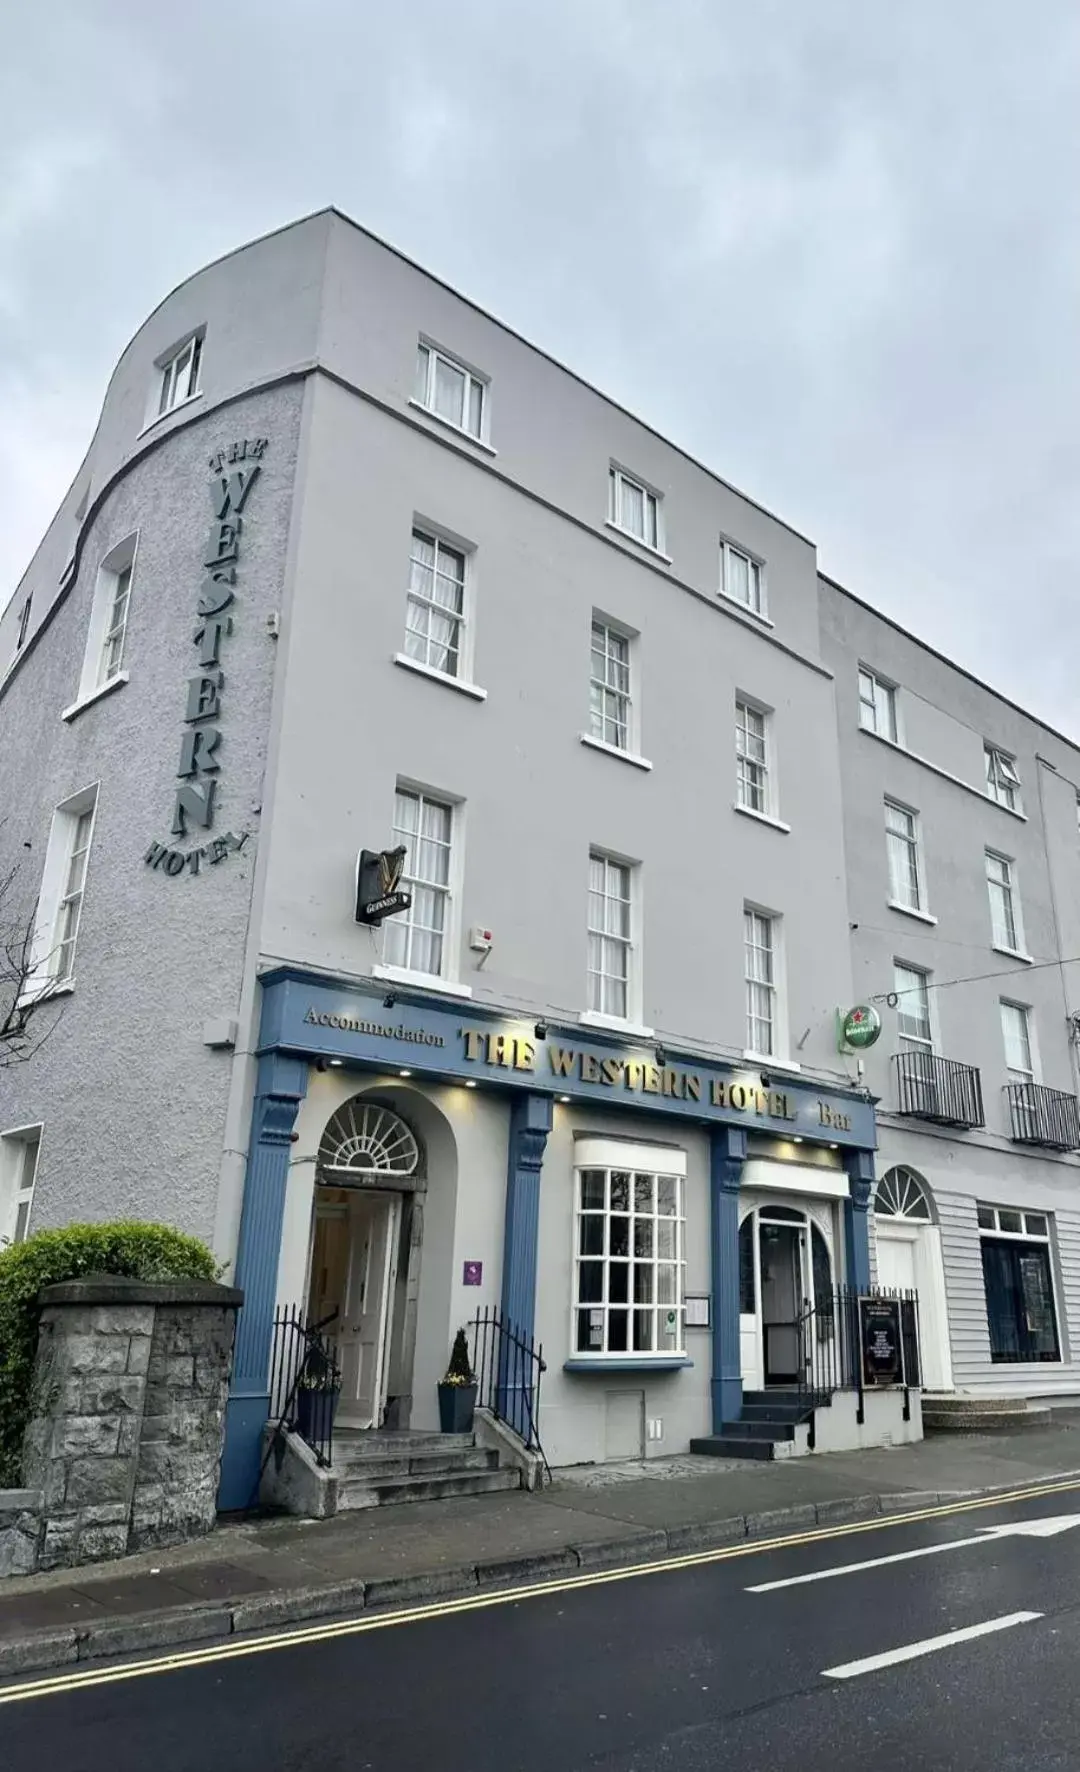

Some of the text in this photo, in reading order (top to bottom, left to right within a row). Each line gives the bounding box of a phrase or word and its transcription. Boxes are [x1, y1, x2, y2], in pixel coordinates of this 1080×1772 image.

[208, 438, 269, 473] THE
[171, 466, 261, 835] WESTERN
[143, 831, 250, 876] HOTEL
[304, 1007, 852, 1132] Accommodation THE WESTERN HOTEL Bar
